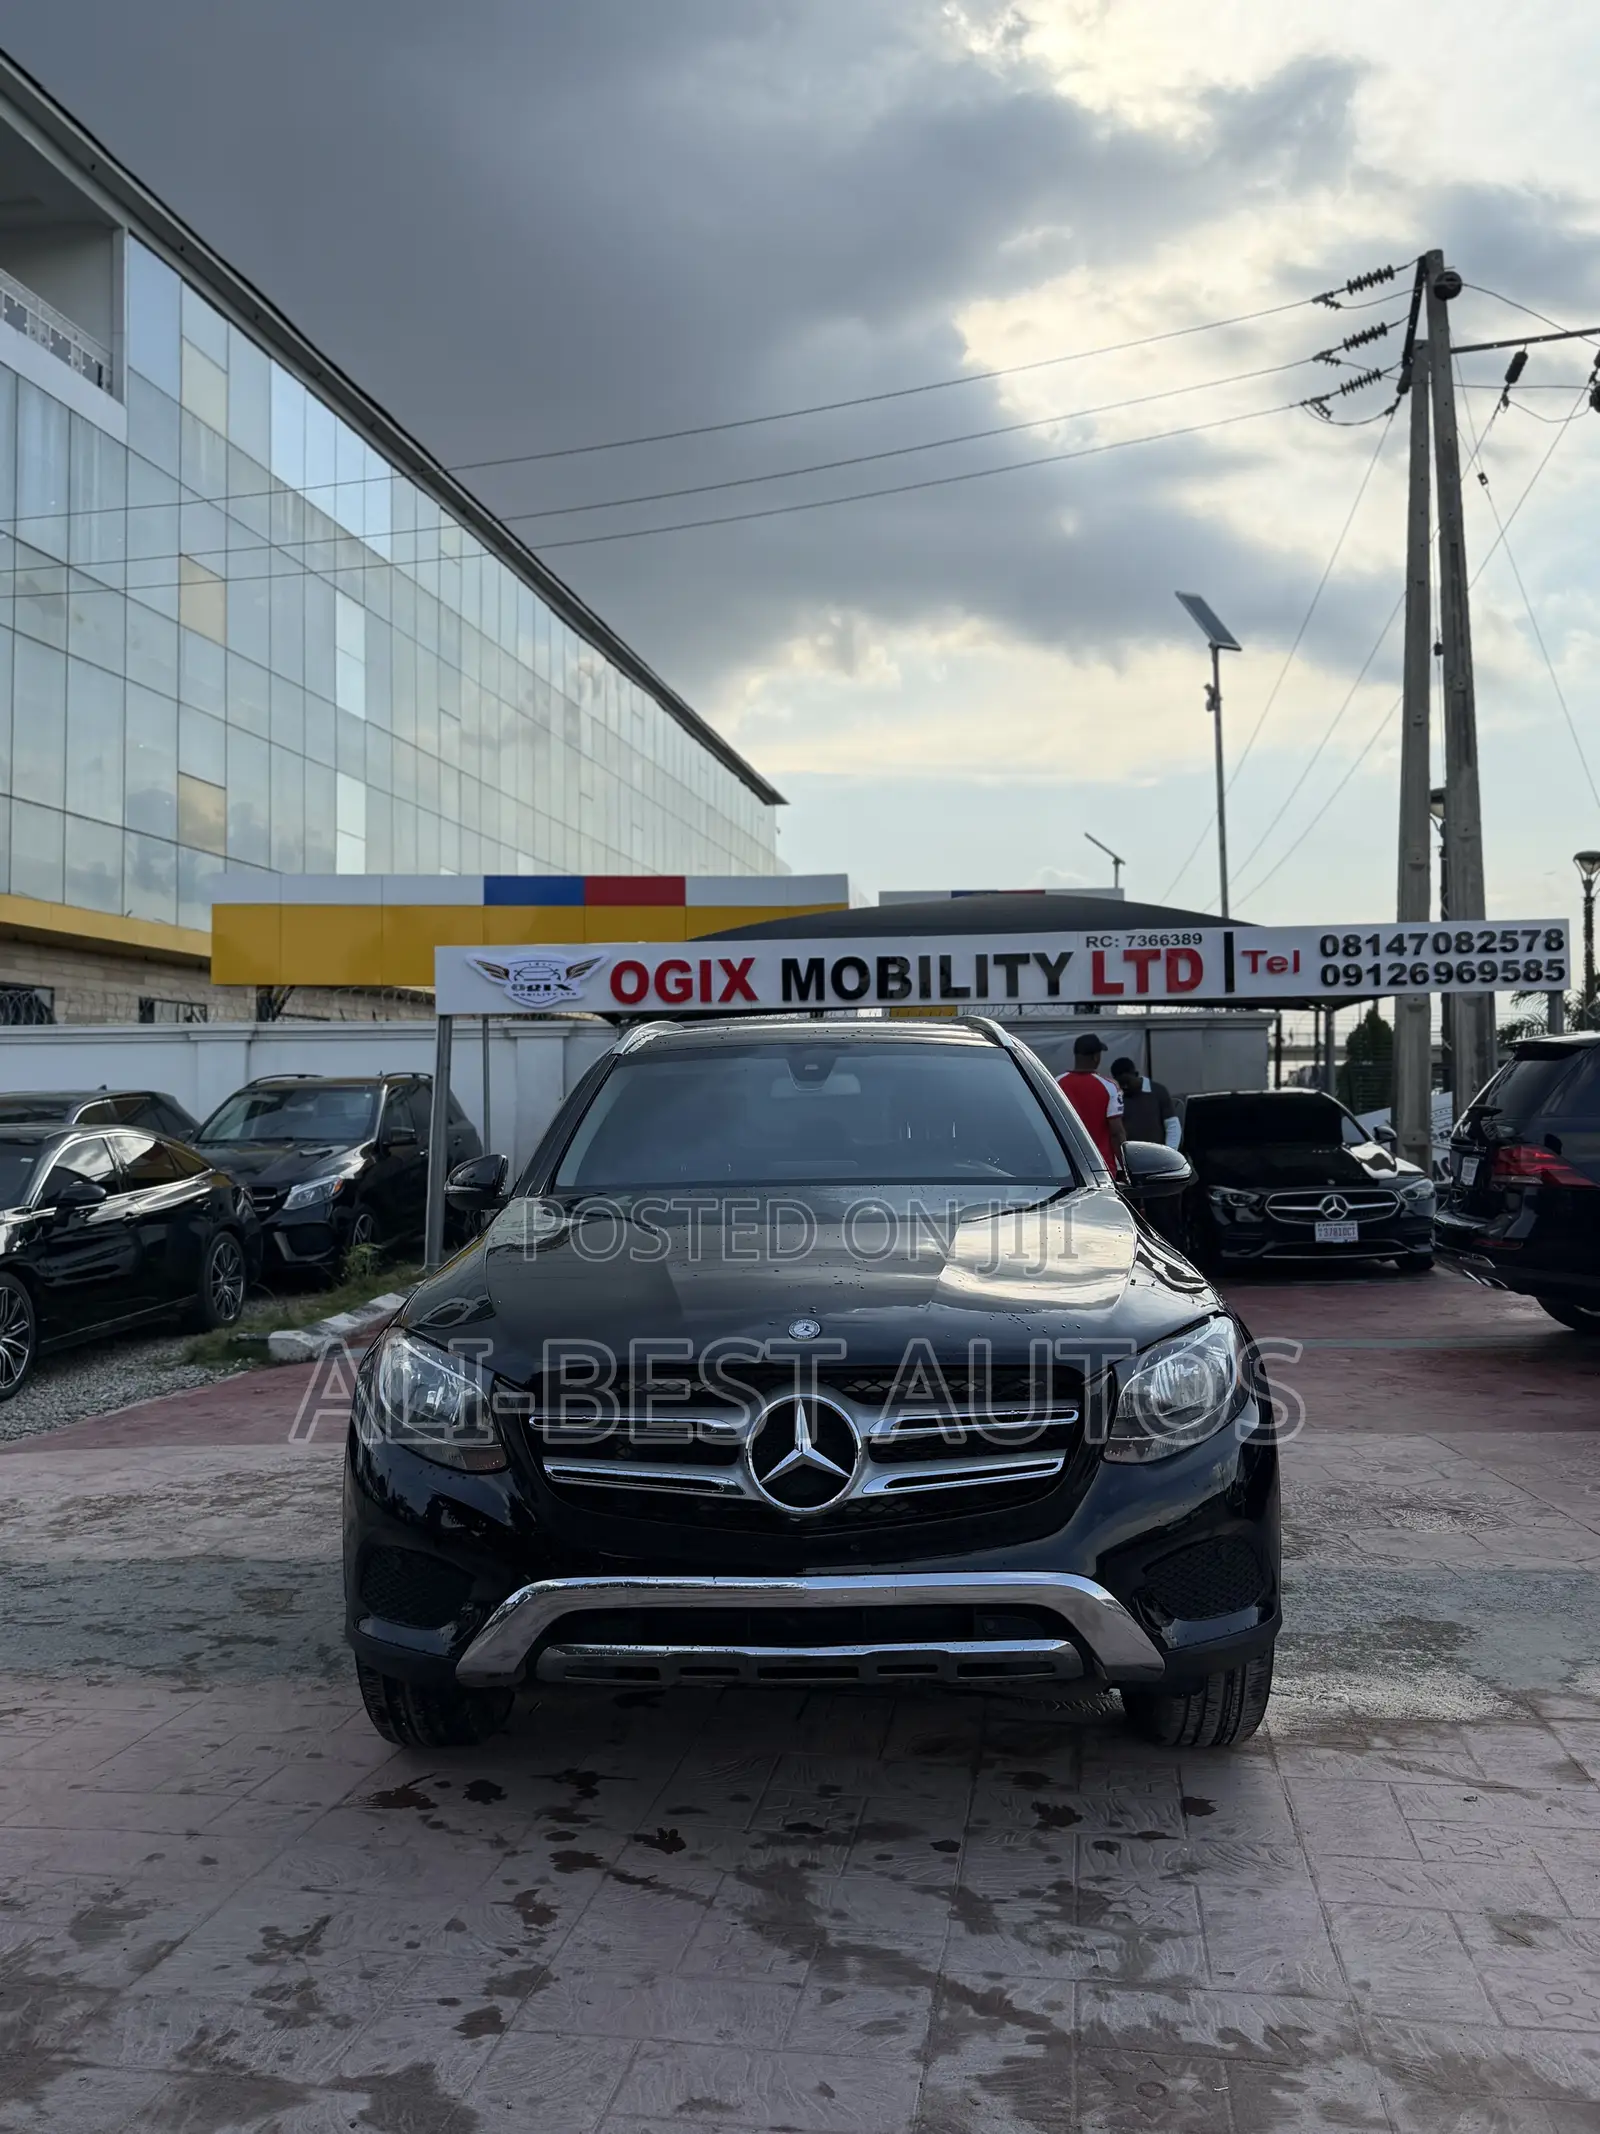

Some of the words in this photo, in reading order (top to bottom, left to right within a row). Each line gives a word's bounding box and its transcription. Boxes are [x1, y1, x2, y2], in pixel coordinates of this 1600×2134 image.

[1086, 935, 1119, 949] RC:
[1126, 933, 1203, 948] 7366389
[1241, 949, 1300, 975] Tel
[1319, 928, 1565, 958] 08147082578
[610, 957, 759, 1005] OGIX
[781, 950, 1074, 1003] MOBILITY
[1092, 948, 1204, 996] LTD
[1320, 958, 1566, 988] 09126969585
